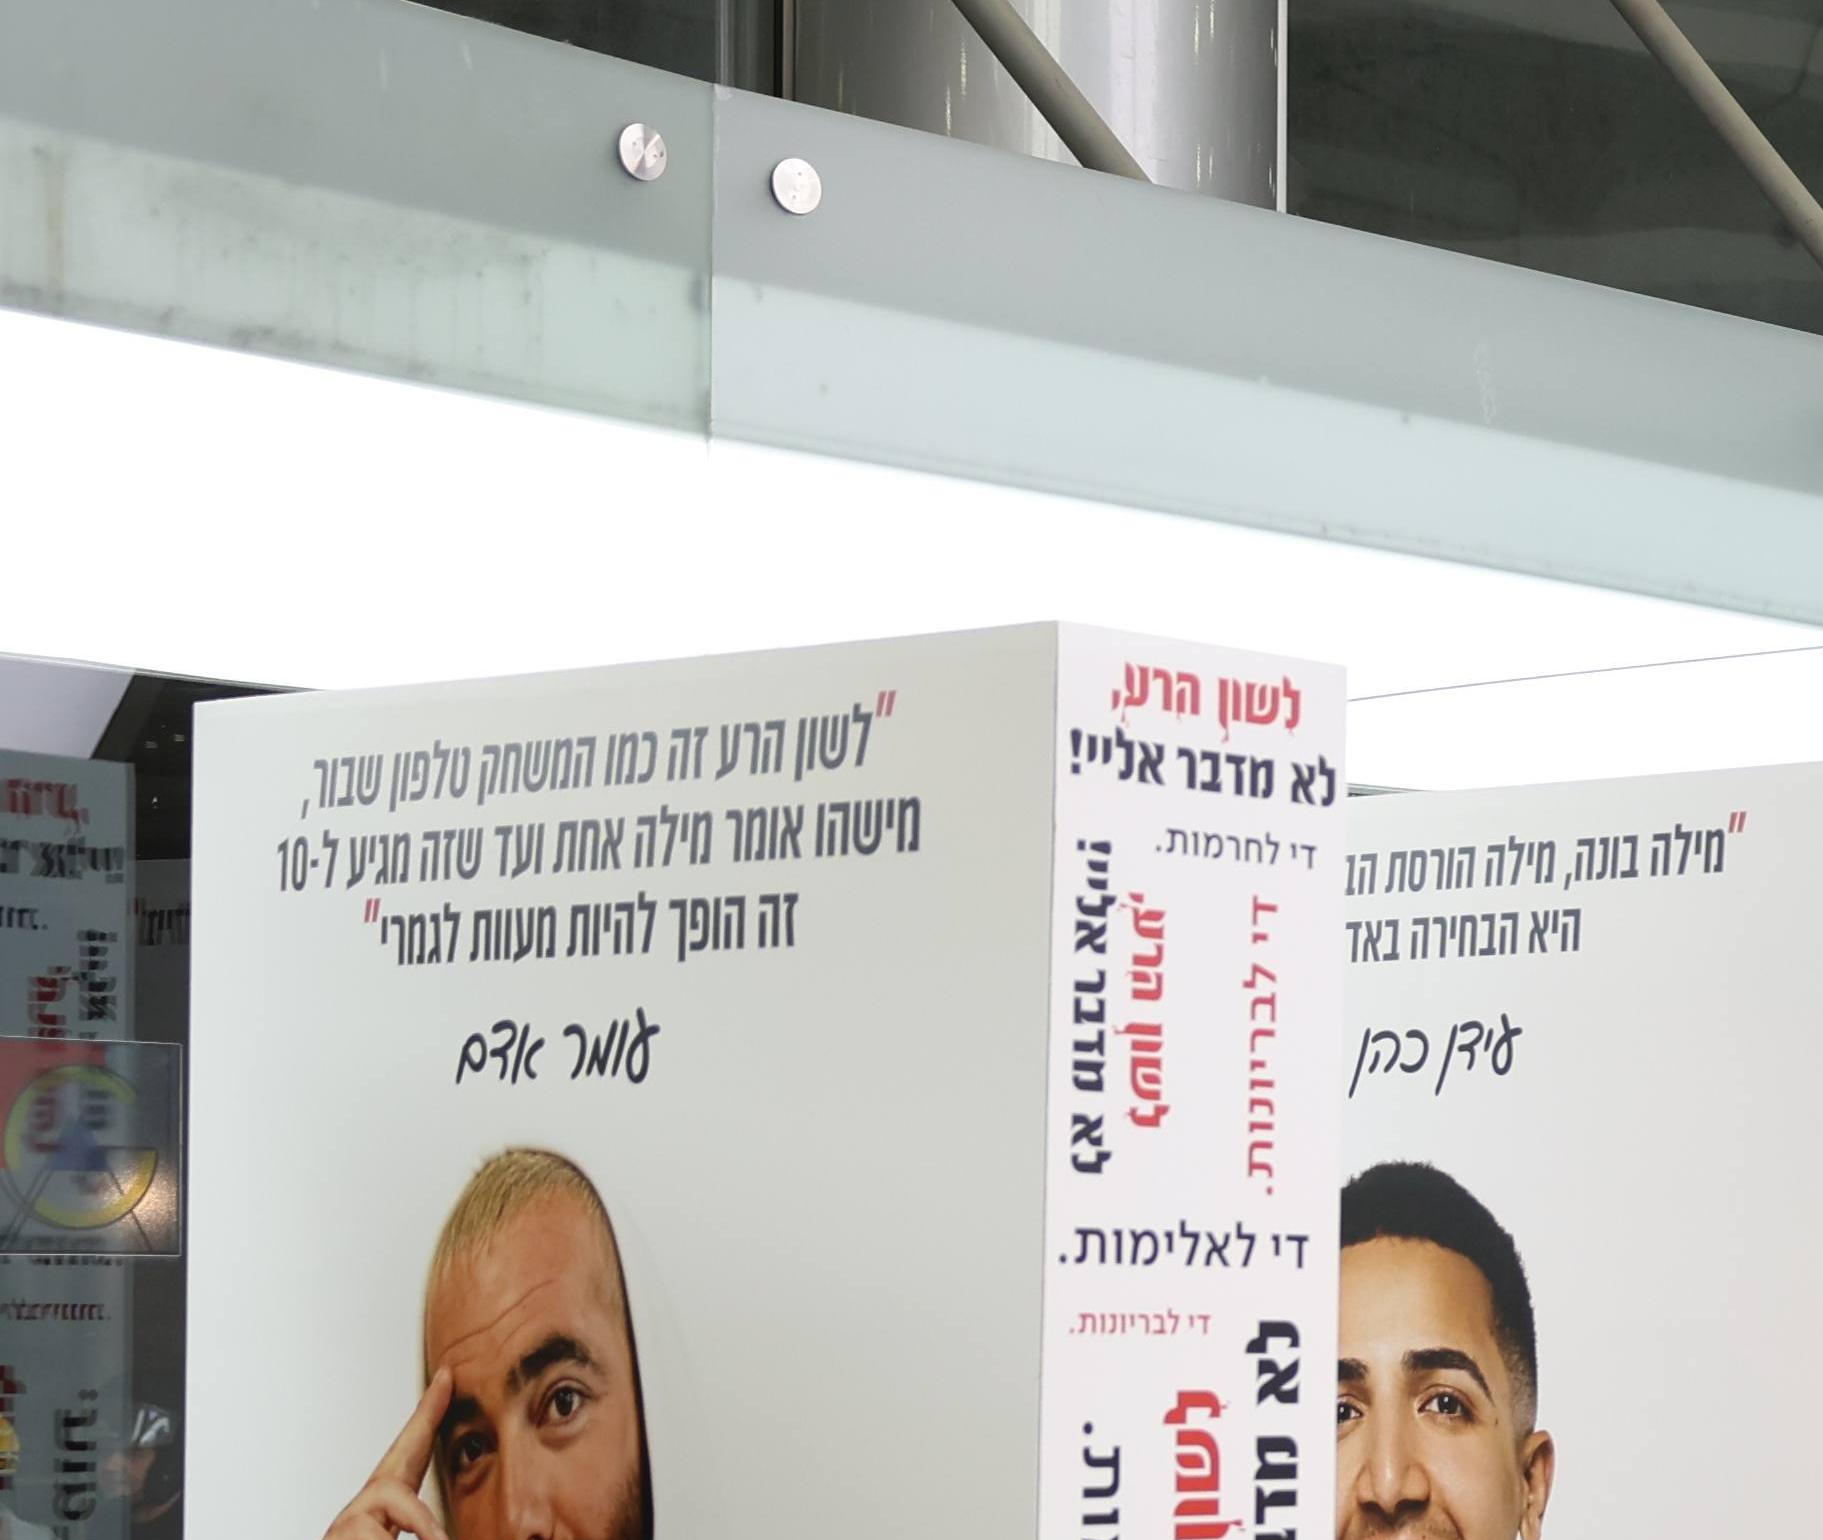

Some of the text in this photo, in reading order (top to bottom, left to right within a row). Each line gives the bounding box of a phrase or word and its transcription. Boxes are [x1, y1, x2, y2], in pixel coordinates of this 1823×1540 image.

[1218, 676, 1301, 743] לשון
[389, 739, 471, 813] טלפון
[476, 735, 597, 806] המשחק
[603, 730, 658, 787] כמו
[666, 725, 710, 782] זה
[714, 719, 786, 782] הרע
[1177, 746, 1275, 799] מדבר
[1290, 755, 1336, 808] לא
[1384, 845, 1477, 894] הורסת
[1484, 835, 1556, 888] מילה
[469, 905, 557, 964] מעוות
[566, 890, 658, 958] להיות
[668, 895, 746, 963] הופך
[757, 892, 799, 949] זה
[455, 1006, 661, 1085] עומר אדם
[1348, 1013, 1523, 1099] עידן כהן
[1187, 1314, 1212, 1335] די
[1245, 1320, 1300, 1405] לא
